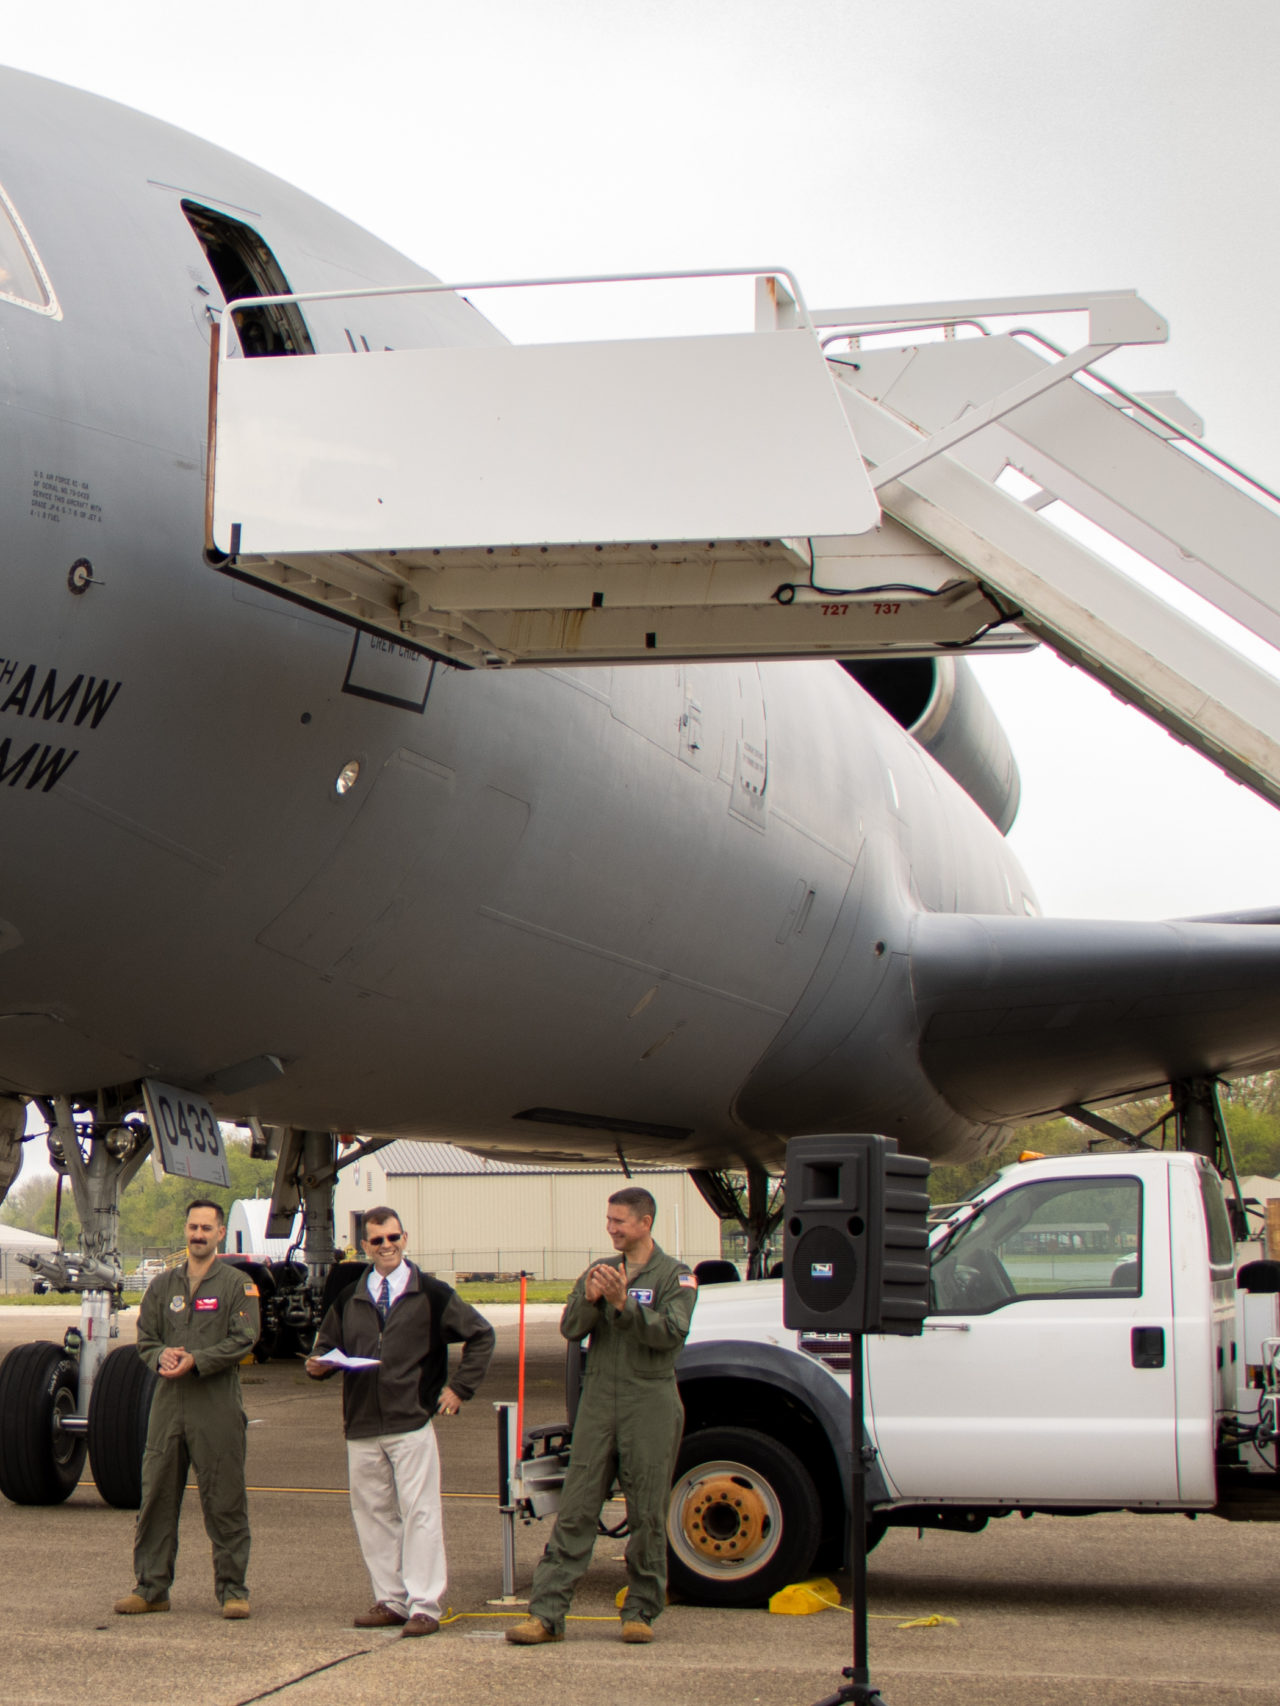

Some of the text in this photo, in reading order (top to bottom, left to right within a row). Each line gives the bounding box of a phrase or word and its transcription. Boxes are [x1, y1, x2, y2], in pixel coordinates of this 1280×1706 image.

[32, 489, 52, 501] SERVICE
[54, 495, 65, 504] THIS
[66, 498, 89, 509] AIRCRAFT
[821, 603, 901, 615] 727 737
[0, 664, 122, 730] AMW
[158, 1095, 219, 1156] 0433
